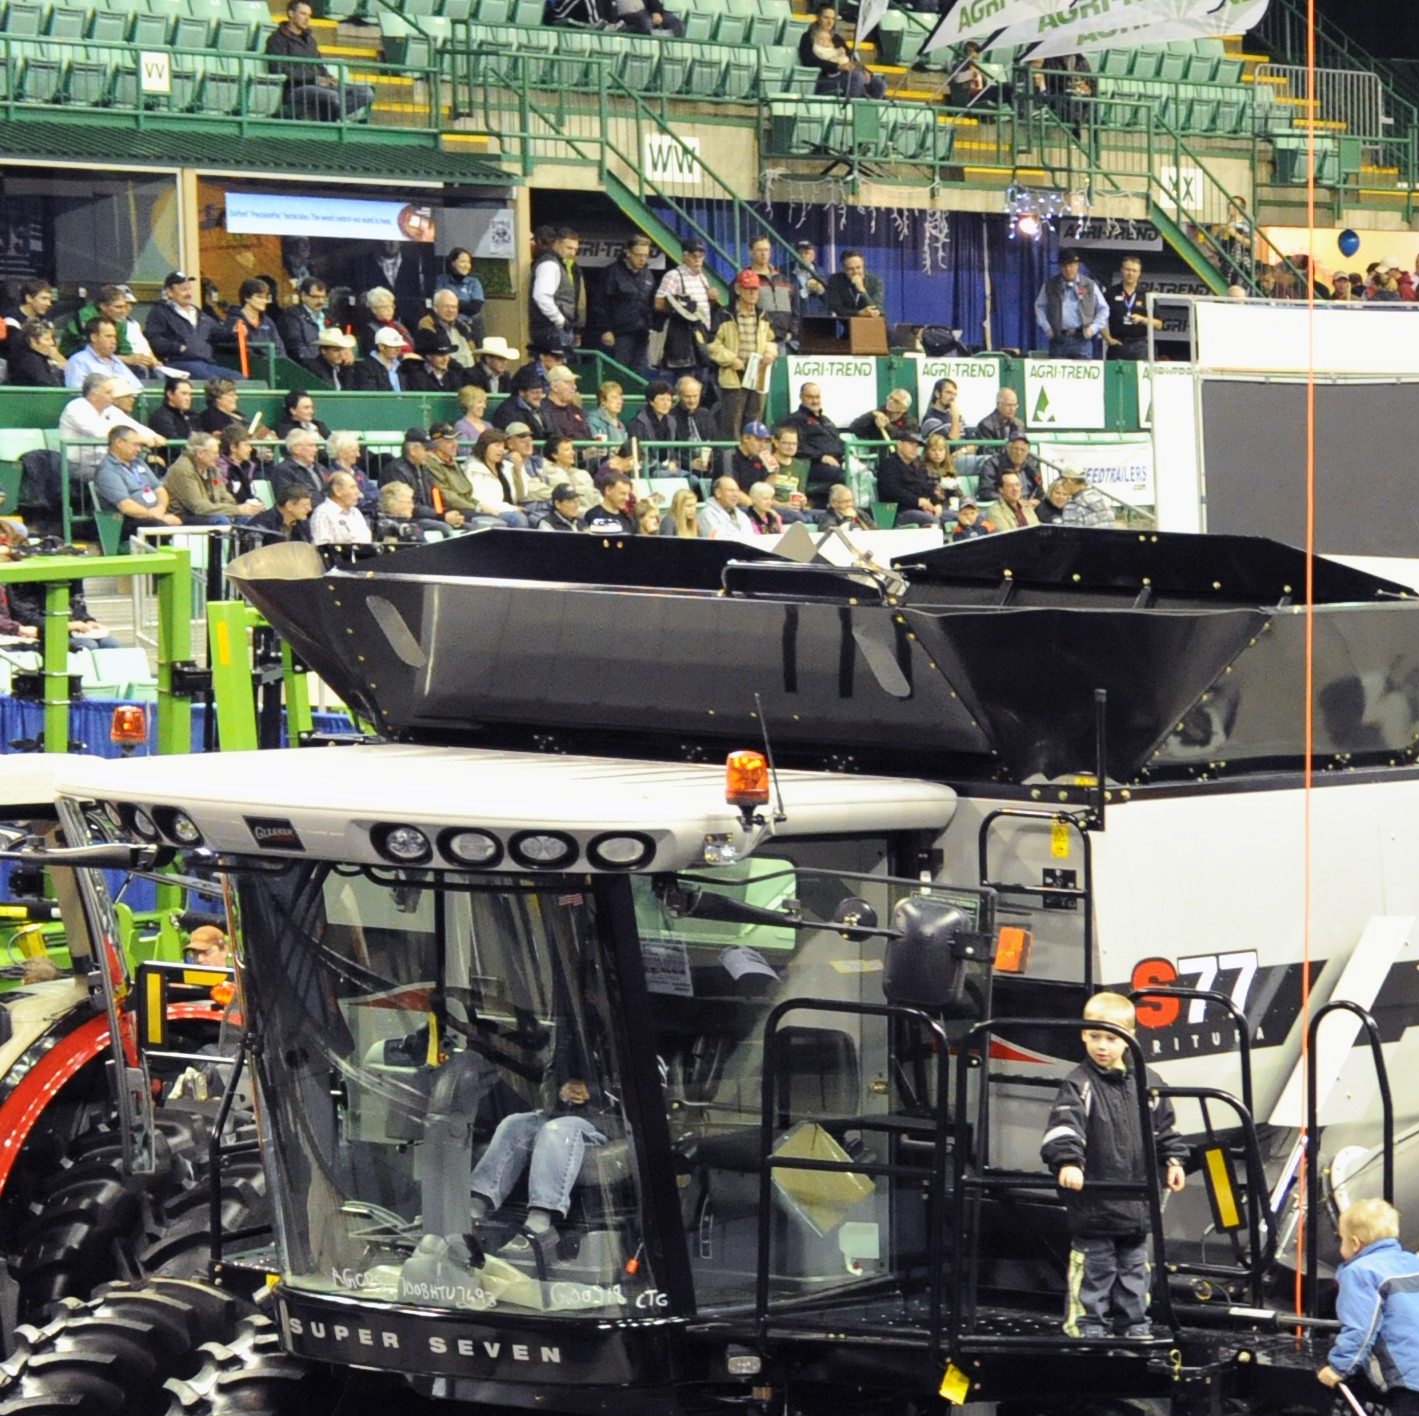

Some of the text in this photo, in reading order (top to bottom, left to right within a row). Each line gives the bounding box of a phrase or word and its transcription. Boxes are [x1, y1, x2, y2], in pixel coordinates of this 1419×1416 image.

[144, 61, 164, 80] W
[649, 143, 696, 174] WW
[794, 361, 872, 377] AGRI-TREND
[922, 362, 996, 378] AGRI-TREND
[1029, 364, 1100, 380] AGRI-TREND
[1131, 949, 1259, 1029] S77
[289, 1316, 562, 1364] SUPER SEVEN
